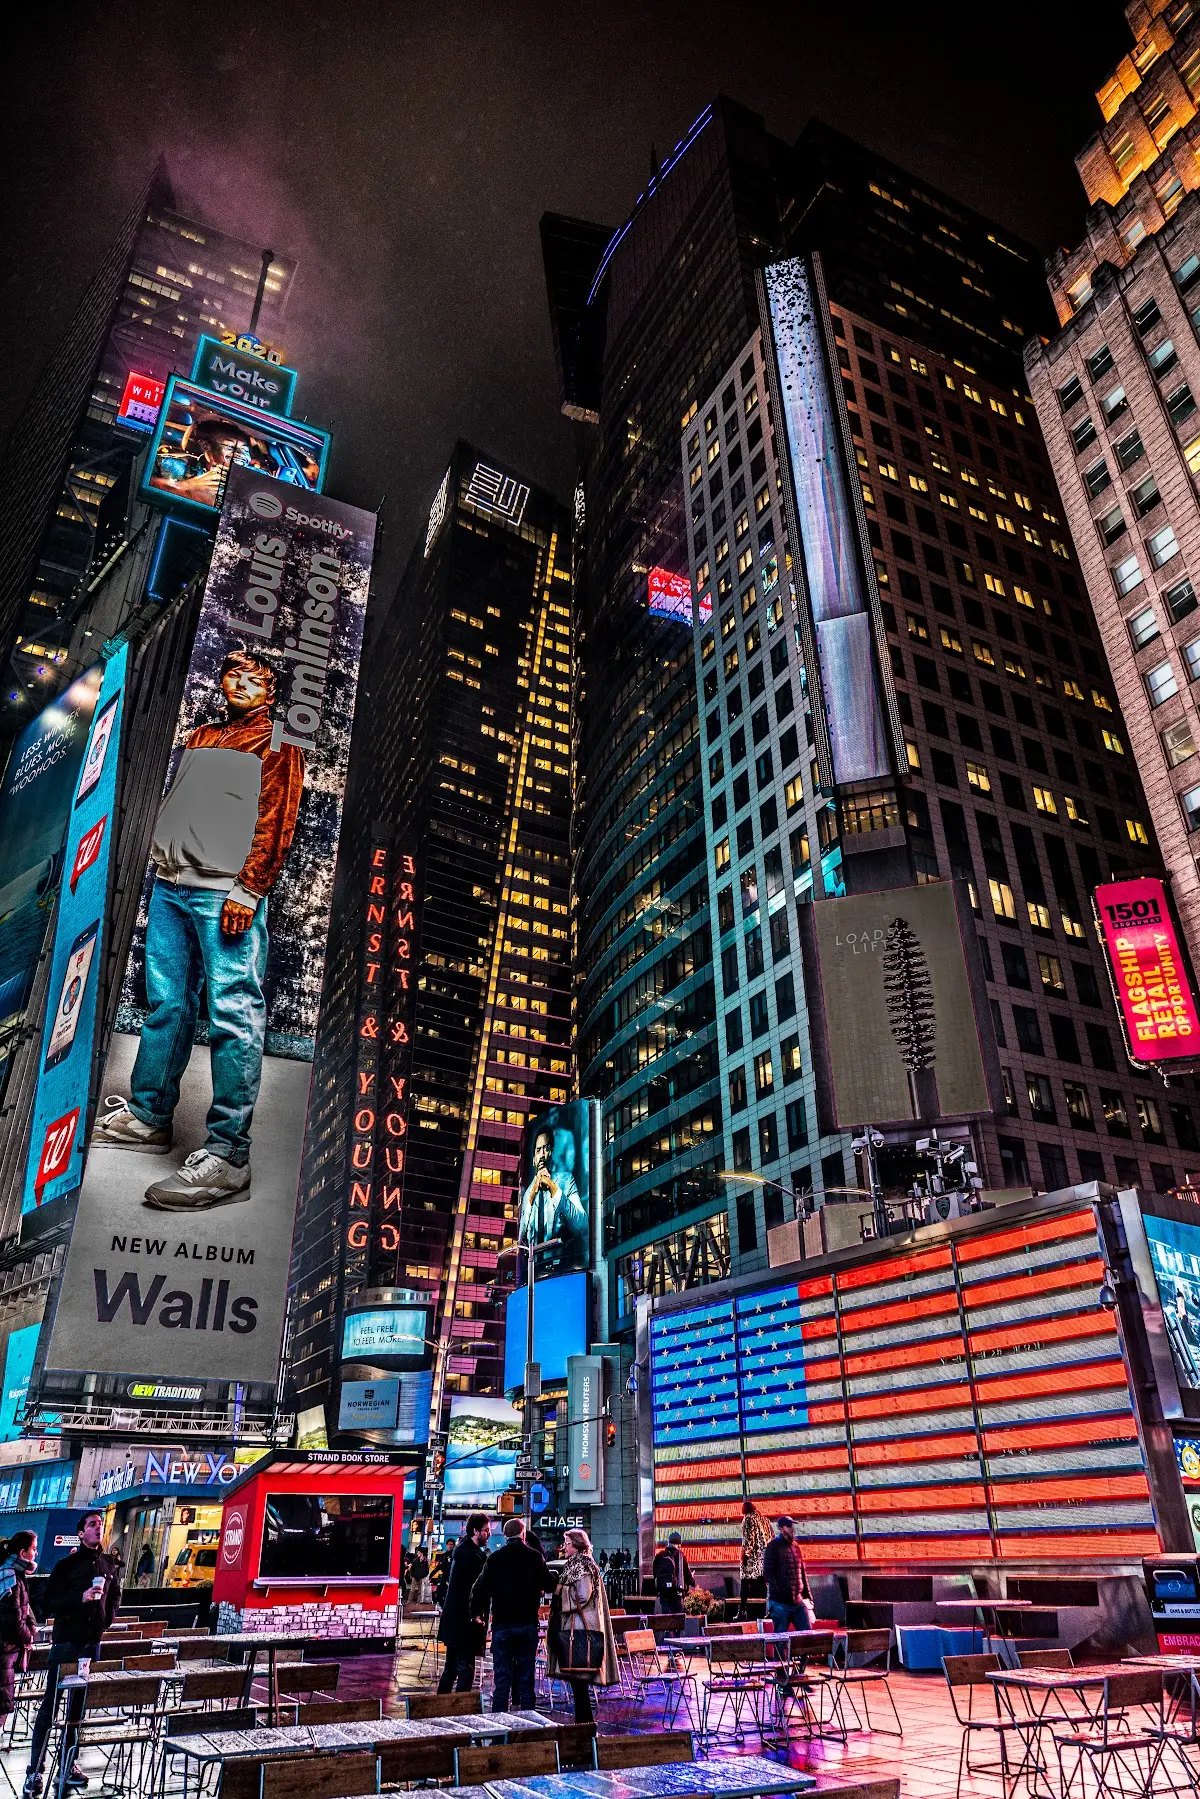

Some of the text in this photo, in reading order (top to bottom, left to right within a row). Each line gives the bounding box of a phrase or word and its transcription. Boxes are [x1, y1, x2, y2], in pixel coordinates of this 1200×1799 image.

[222, 331, 282, 366] 2020
[210, 356, 280, 394] Make
[212, 380, 271, 408] your
[285, 507, 352, 540] Spotify
[228, 534, 287, 639] Louis
[269, 553, 342, 752] Tomlinson
[21, 706, 81, 763] LESS WINTER
[46, 723, 77, 755] MORE
[1104, 898, 1161, 922] 1501
[1113, 916, 1162, 929] BROADWAY
[1115, 937, 1157, 1041] FLAGSHIP
[1143, 965, 1177, 1038] RETAIL
[1153, 933, 1192, 1036] OPPORTUNITY
[347, 848, 388, 1248] ERNST & YOUNG
[111, 1235, 255, 1265] NEW ALBUM
[93, 1268, 259, 1334] Walls
[360, 1325, 394, 1335] FEEL FREE
[131, 1383, 202, 1400] NEWTRADITION
[347, 1400, 390, 1408] NORWEGIAN
[582, 1376, 590, 1459] THOMSON REUTERS
[307, 1452, 390, 1463] STRAND BOOK STORE
[540, 1516, 584, 1528] CHASE
